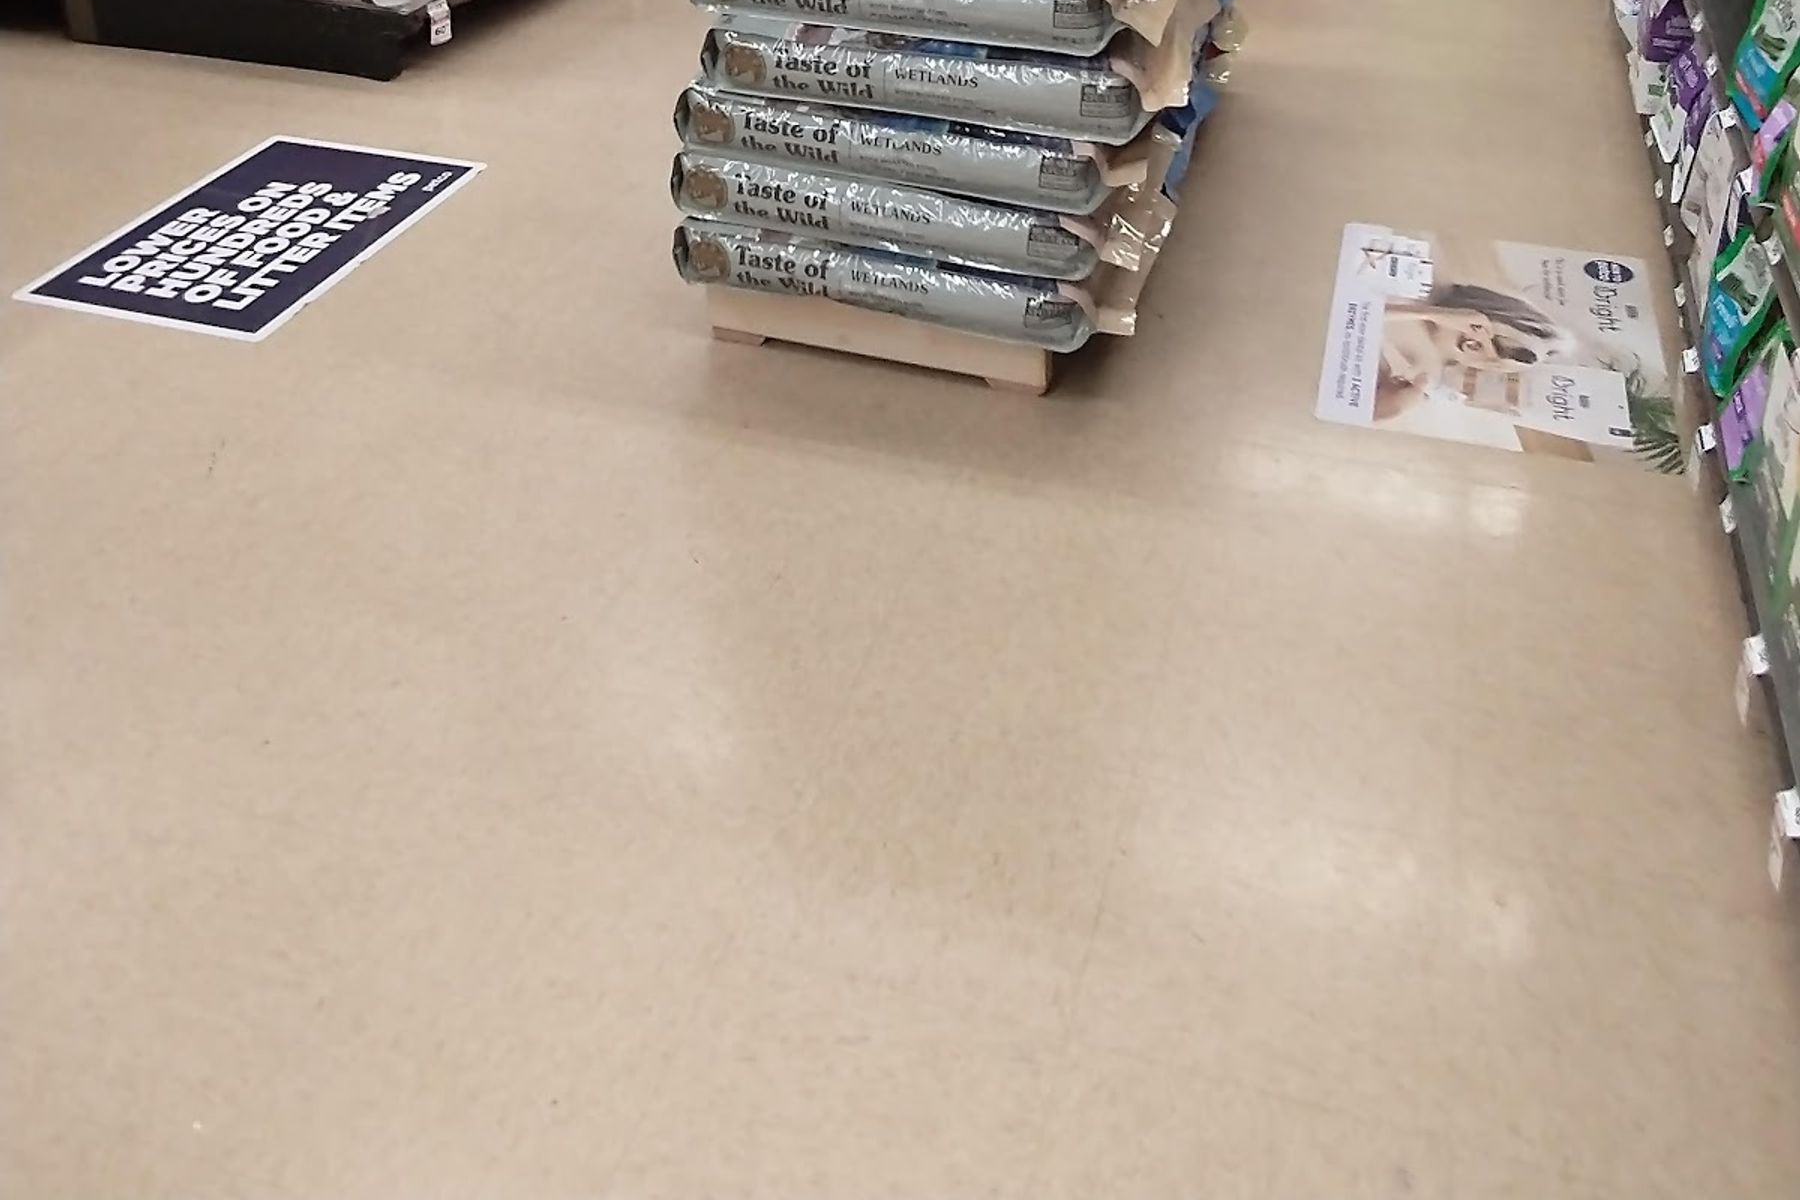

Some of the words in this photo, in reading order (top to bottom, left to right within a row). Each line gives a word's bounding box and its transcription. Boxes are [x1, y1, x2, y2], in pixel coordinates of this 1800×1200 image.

[773, 46, 838, 75] Taste
[846, 57, 874, 80] of
[895, 68, 978, 88] WETLANDS
[772, 74, 809, 91] the
[817, 78, 875, 99] Wild
[741, 107, 804, 138] Taste
[813, 123, 840, 145] of
[741, 135, 777, 152] the
[784, 141, 839, 164] Wild
[860, 133, 942, 156] WETLANDS
[421, 171, 453, 192] petco
[734, 172, 797, 204] Taste
[804, 189, 829, 211] of
[734, 200, 769, 219] the
[776, 207, 829, 230] Wild
[851, 200, 931, 225] WETLANDS
[79, 207, 218, 288] LOWER
[112, 214, 242, 293] PRICES
[237, 181, 301, 214] ON
[145, 180, 334, 298] HUNDREDS
[184, 270, 239, 304] OF
[245, 209, 334, 268] FOOD
[325, 190, 358, 206] &
[213, 233, 340, 311] LITTER
[324, 171, 422, 230] ITEMS
[735, 245, 797, 274] Taste
[804, 259, 830, 280] of
[736, 272, 772, 289] the
[851, 270, 929, 295] WETLANDS
